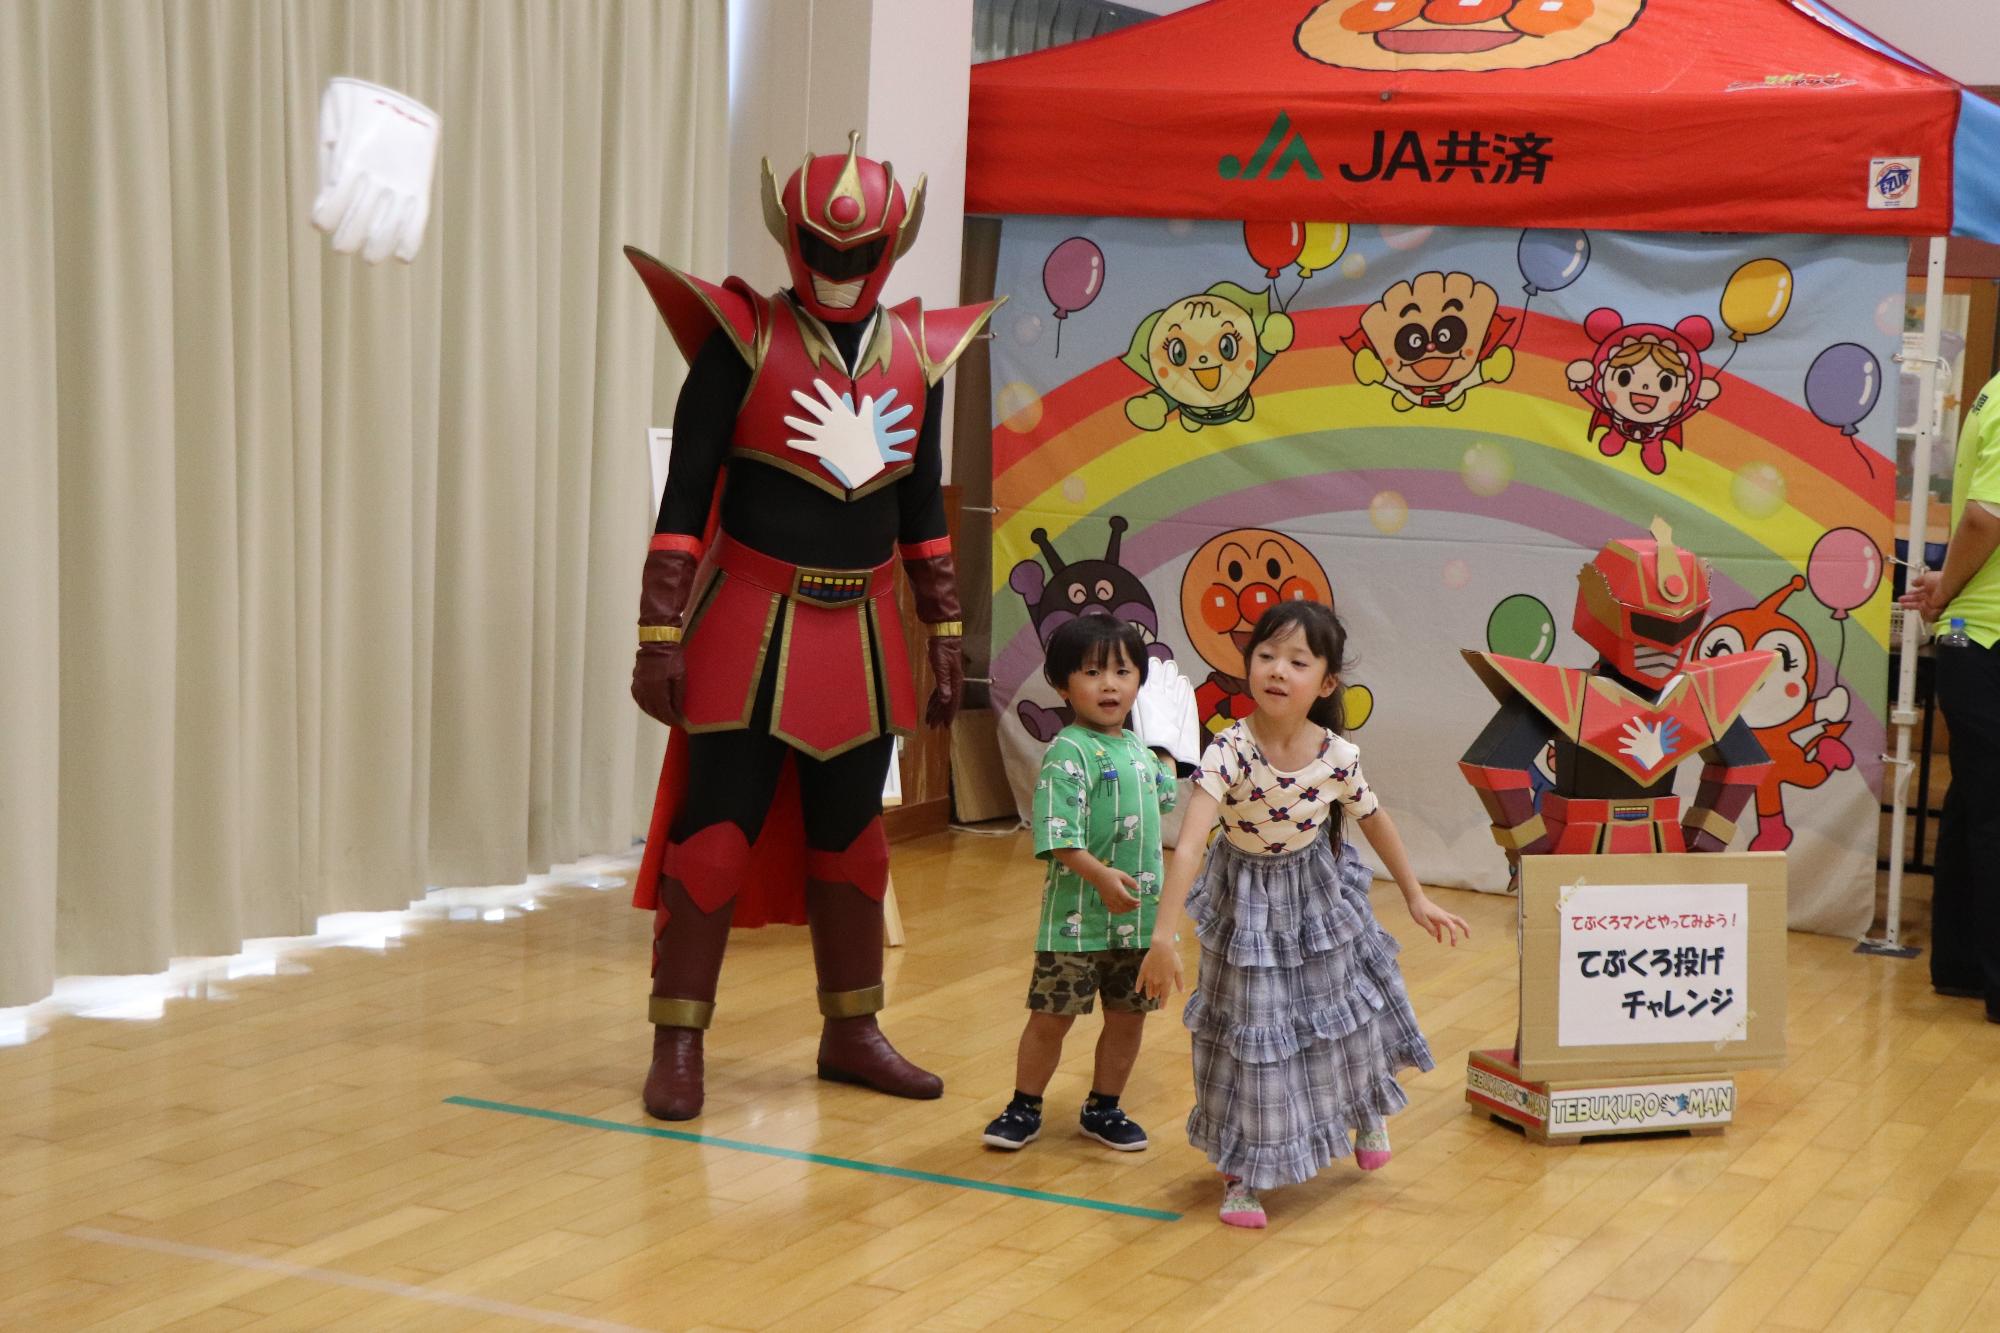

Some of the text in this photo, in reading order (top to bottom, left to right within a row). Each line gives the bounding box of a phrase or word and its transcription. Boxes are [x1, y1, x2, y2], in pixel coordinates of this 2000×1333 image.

[1339, 130, 1554, 185] JA共済
[1577, 946, 1726, 978] てぶくろ投げ
[1621, 988, 1734, 1020] チャレンジ
[1551, 1086, 1734, 1126] TEBUKURO MAN
